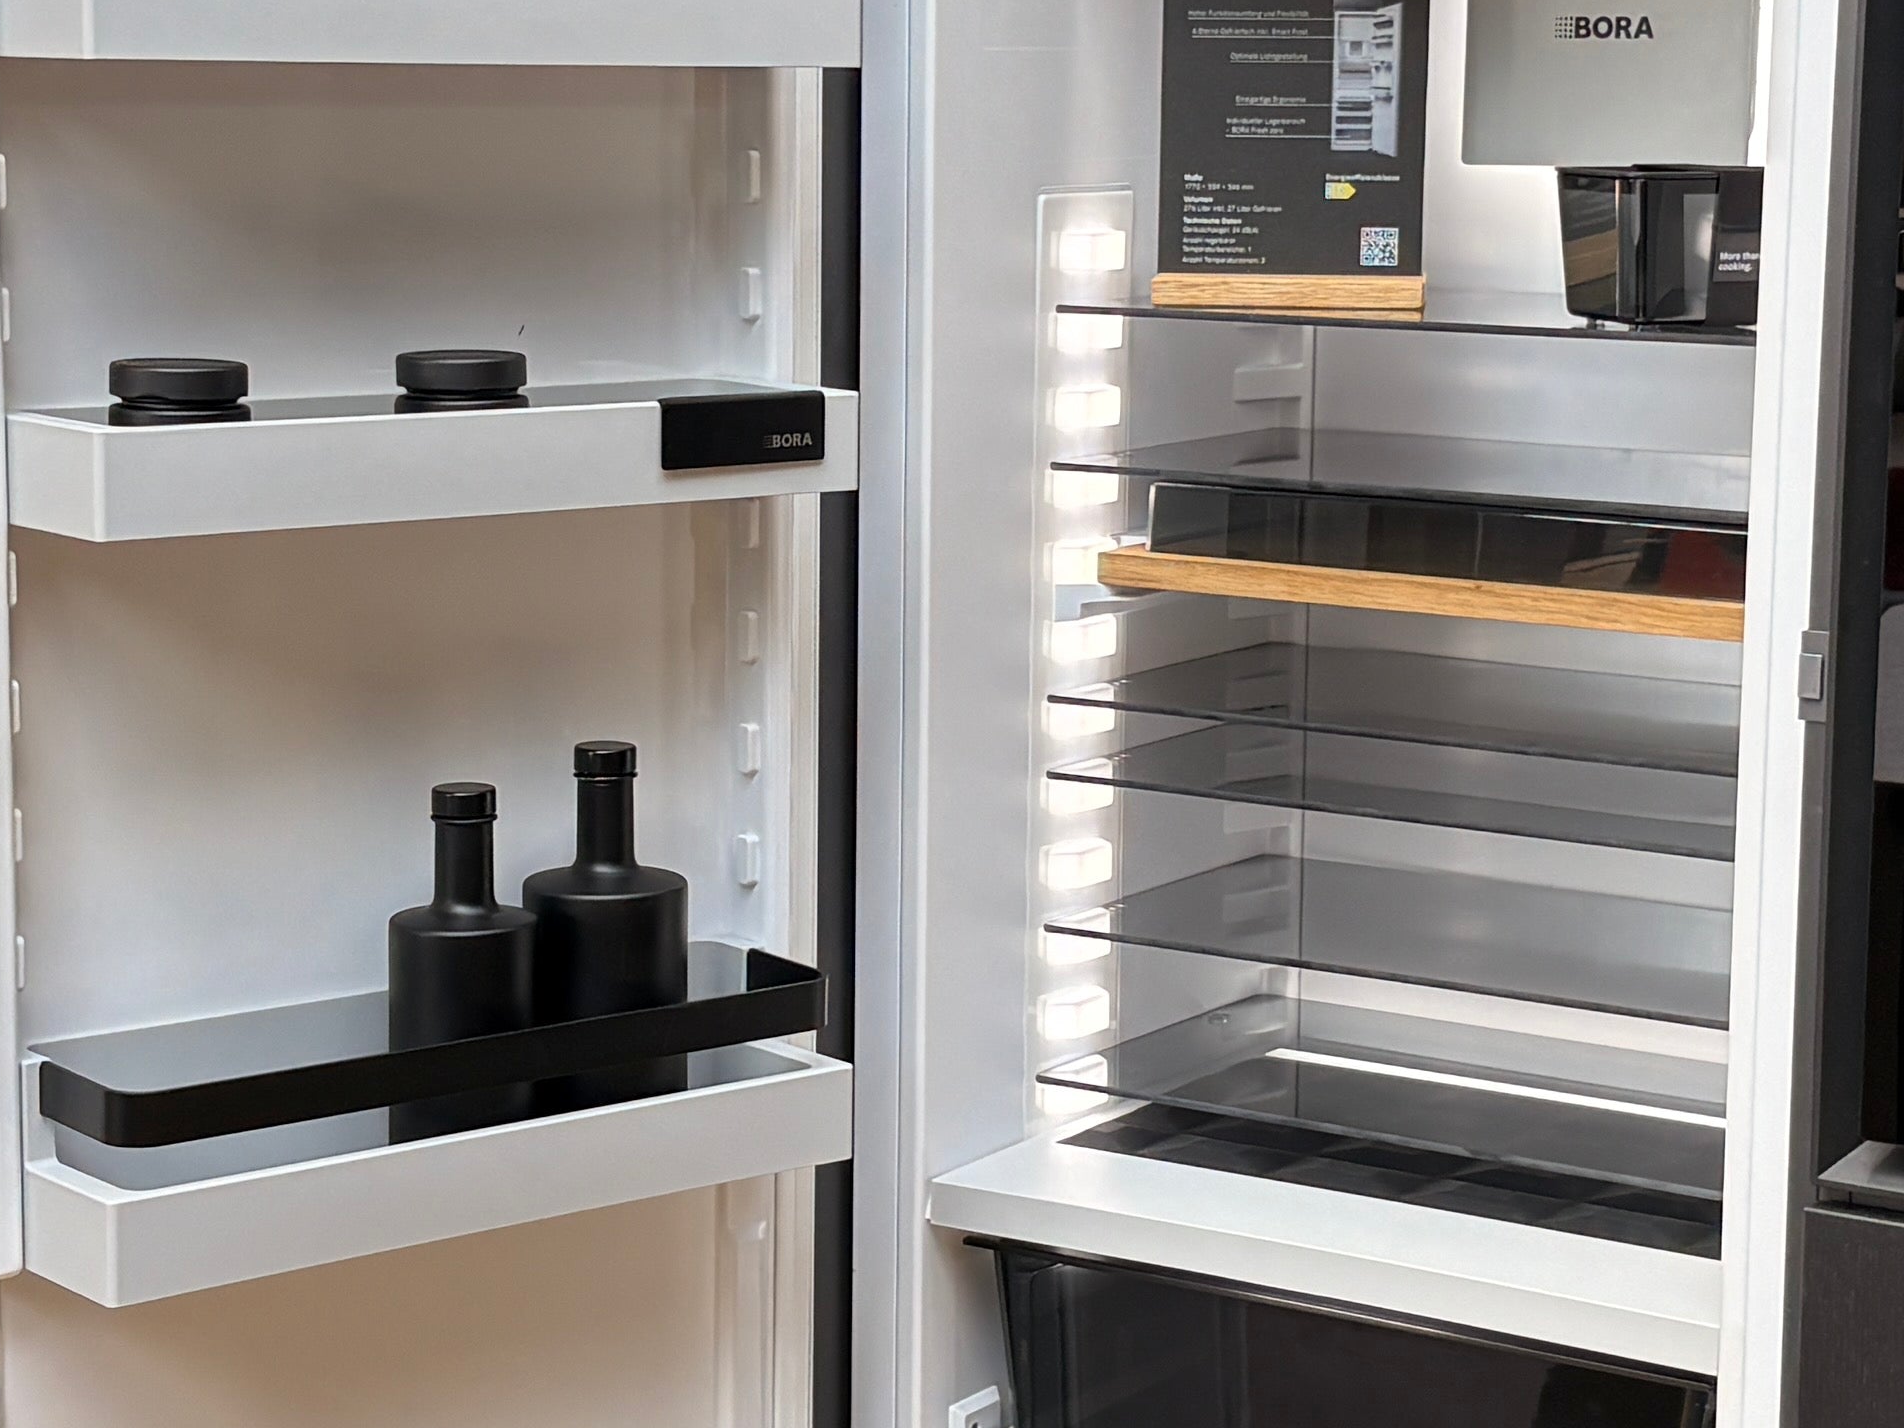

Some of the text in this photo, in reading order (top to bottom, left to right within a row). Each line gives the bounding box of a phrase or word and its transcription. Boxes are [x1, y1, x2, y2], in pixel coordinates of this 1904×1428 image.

[1574, 16, 1654, 39] BORA
[1719, 252, 1742, 261] More
[771, 432, 813, 448] BORA
